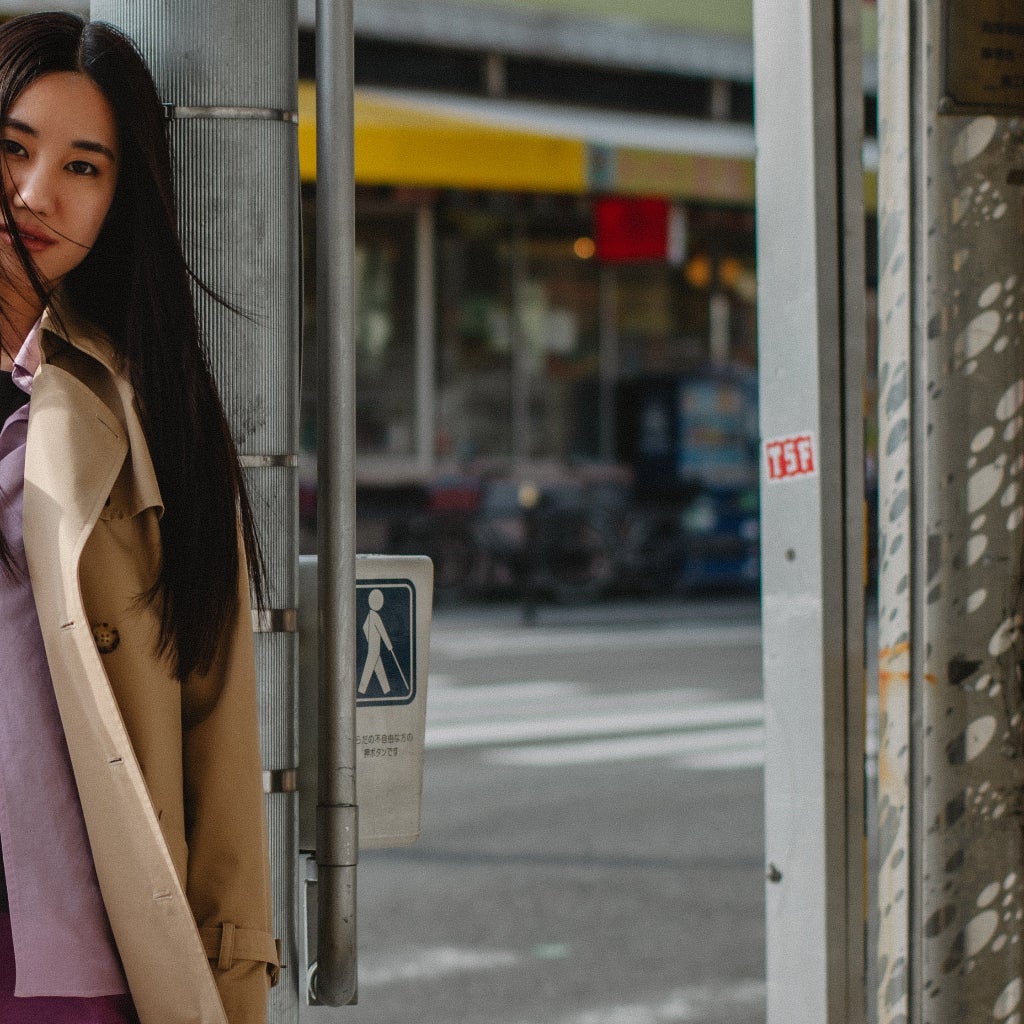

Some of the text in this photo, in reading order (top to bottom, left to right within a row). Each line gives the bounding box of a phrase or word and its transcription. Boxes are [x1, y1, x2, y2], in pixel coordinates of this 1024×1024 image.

[356, 733, 413, 744] らだの不自由な方の
